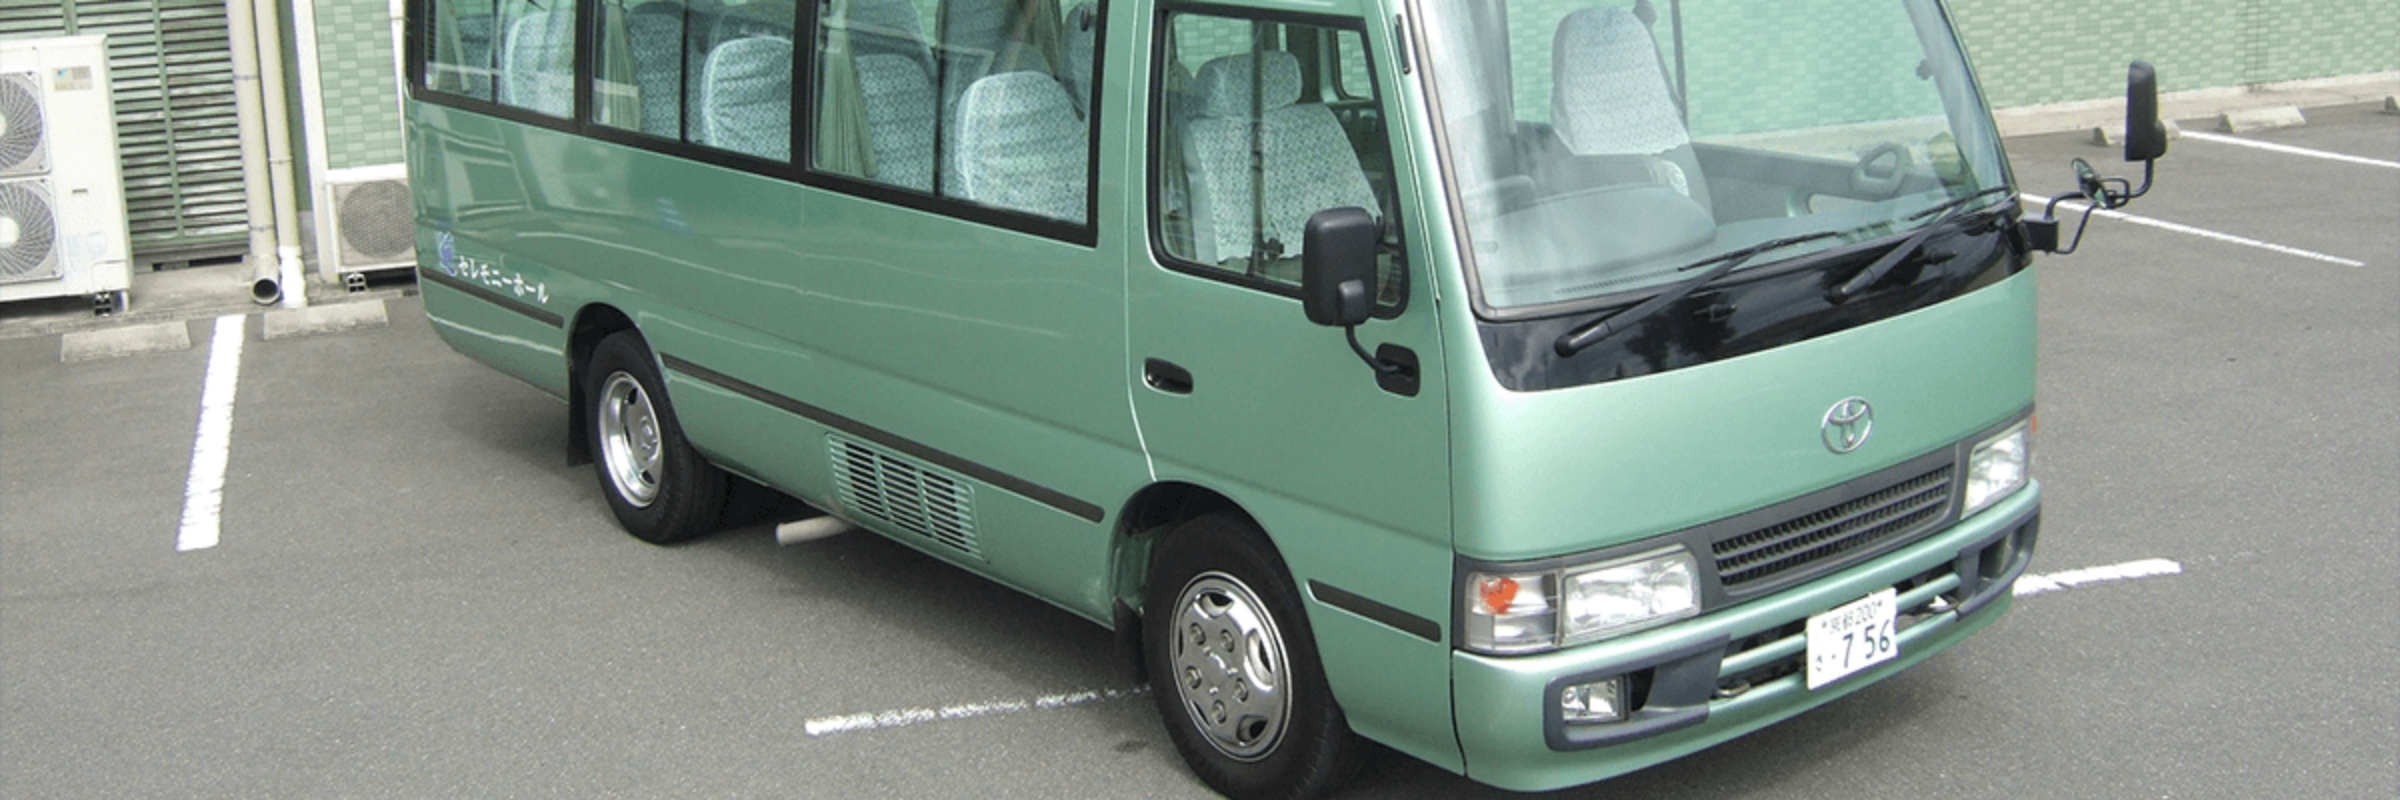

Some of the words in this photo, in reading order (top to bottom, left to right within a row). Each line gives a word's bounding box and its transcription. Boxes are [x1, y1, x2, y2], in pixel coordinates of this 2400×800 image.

[458, 255, 549, 304] セレモニーホール
